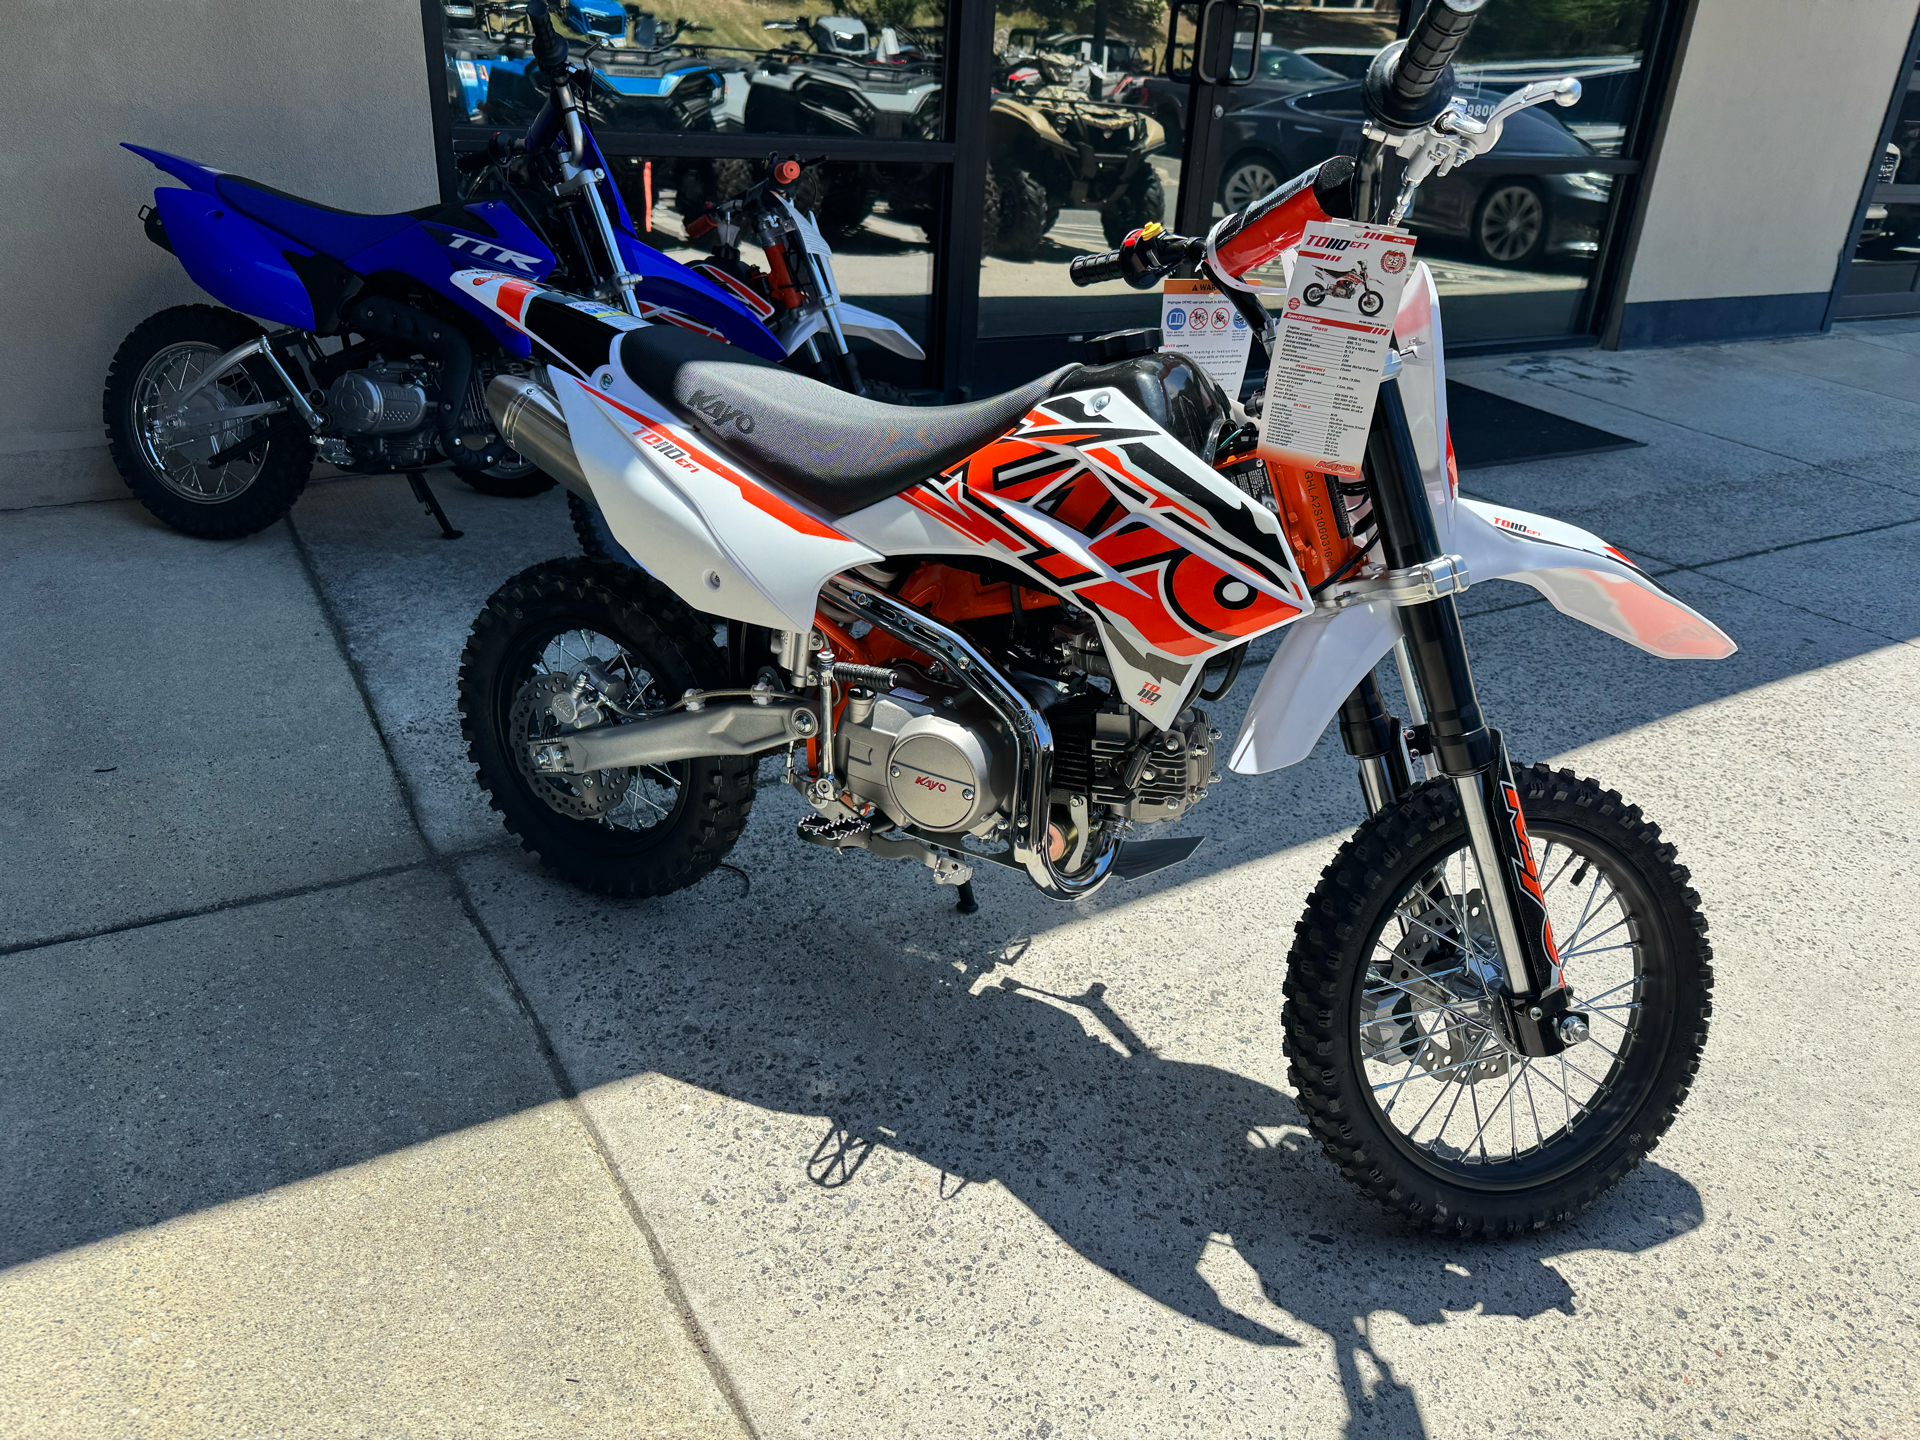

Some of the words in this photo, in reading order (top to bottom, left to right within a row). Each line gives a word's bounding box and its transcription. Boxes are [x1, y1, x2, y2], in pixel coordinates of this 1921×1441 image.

[449, 233, 543, 272] TTR
[1387, 256, 1400, 266] 25
[383, 389, 417, 402] YAMAHA
[688, 389, 755, 435] KAYO
[915, 776, 947, 792] KAYO
